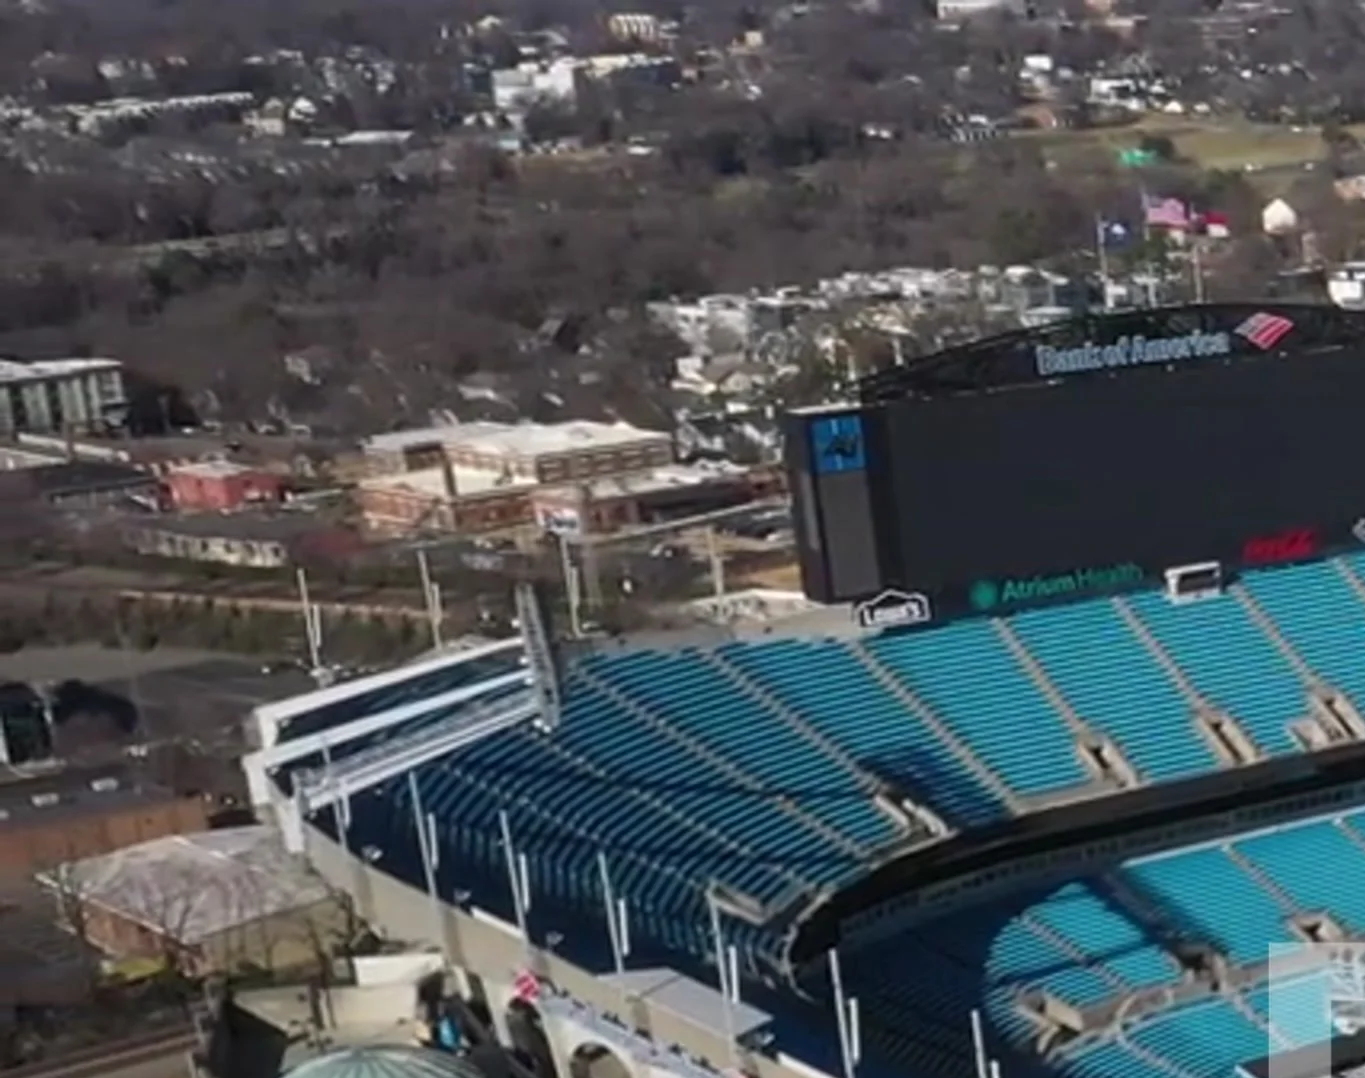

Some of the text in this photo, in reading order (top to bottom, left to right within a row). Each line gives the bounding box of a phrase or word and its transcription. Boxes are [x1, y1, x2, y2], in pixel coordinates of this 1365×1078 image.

[1036, 328, 1230, 376] Bank of America
[1001, 562, 1145, 602] Atrium Health
